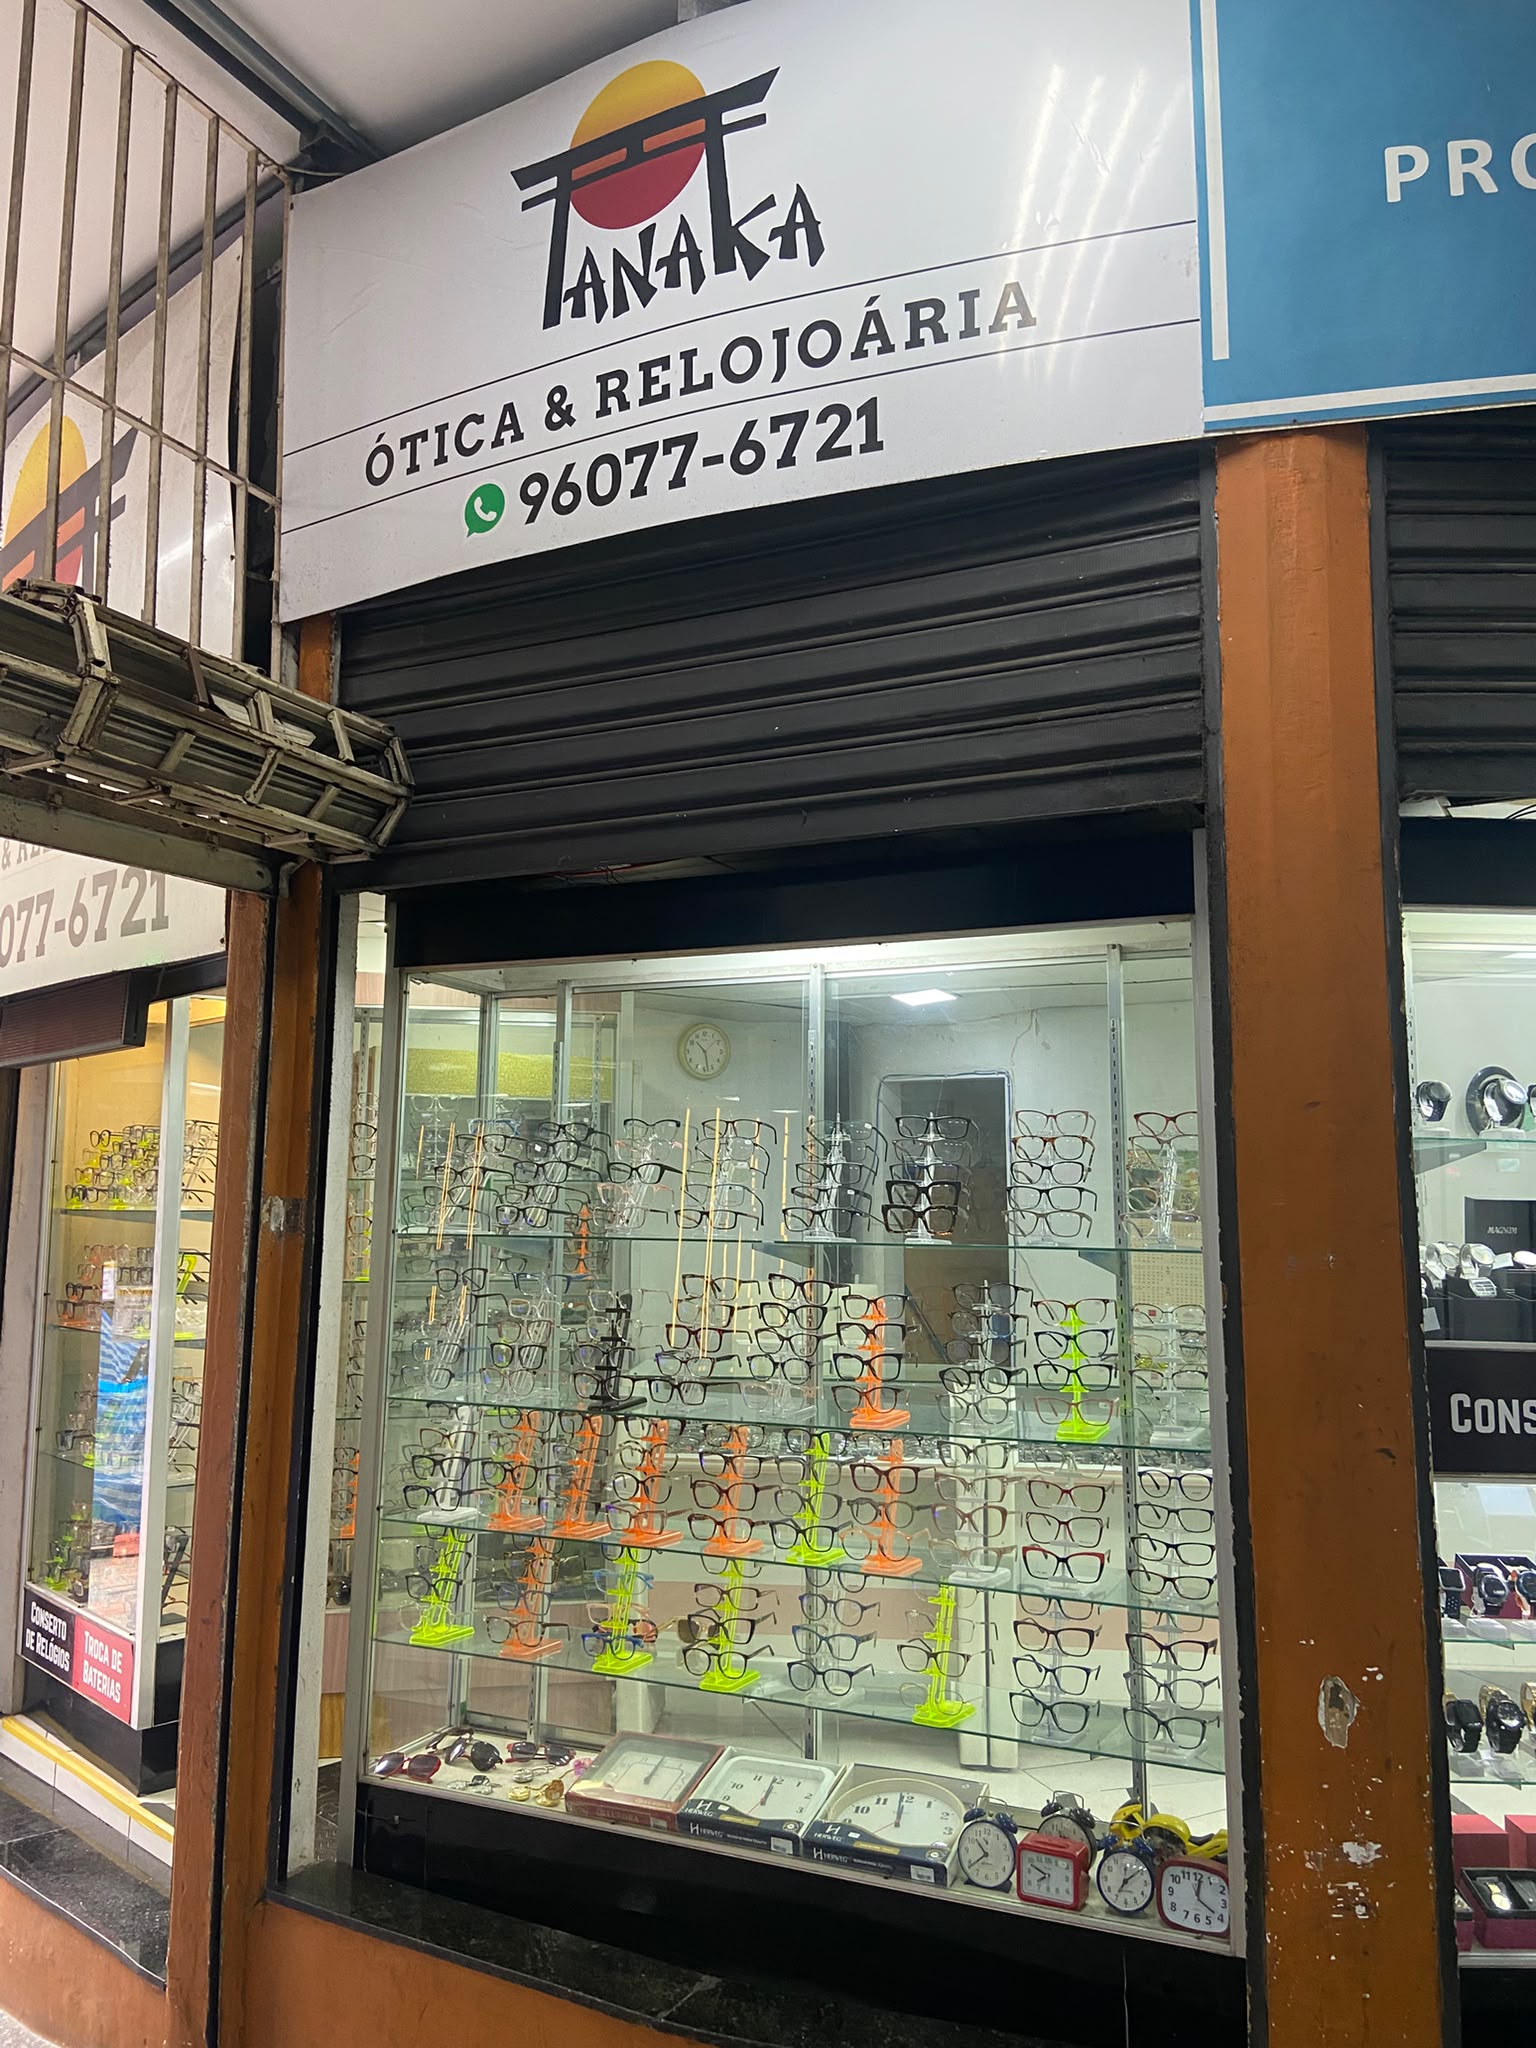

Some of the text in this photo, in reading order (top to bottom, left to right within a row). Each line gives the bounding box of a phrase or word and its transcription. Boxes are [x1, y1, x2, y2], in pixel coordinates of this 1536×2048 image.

[511, 66, 826, 331] TANAKA
[365, 281, 1038, 487] ÓTICA & RELOJOÁRIA
[519, 397, 885, 526] 96077-6721
[1450, 1393, 1536, 1435] CONS
[30, 1601, 68, 1641] CONSERTO
[25, 1628, 71, 1672] DE RELÓGIOS
[84, 1630, 123, 1674] TROCA DE
[82, 1659, 121, 1704] BATERIAS
[1170, 1874, 1181, 1884] 10
[1181, 1870, 1191, 1880] 11
[1168, 1886, 1174, 1896] 9
[1219, 1885, 1226, 1896] 2
[1170, 1901, 1177, 1912] 8
[1221, 1899, 1227, 1909] 3
[1183, 1909, 1190, 1920] 7
[1194, 1913, 1201, 1923] 6
[1205, 1915, 1212, 1925] 5
[1217, 1913, 1224, 1923] 4
